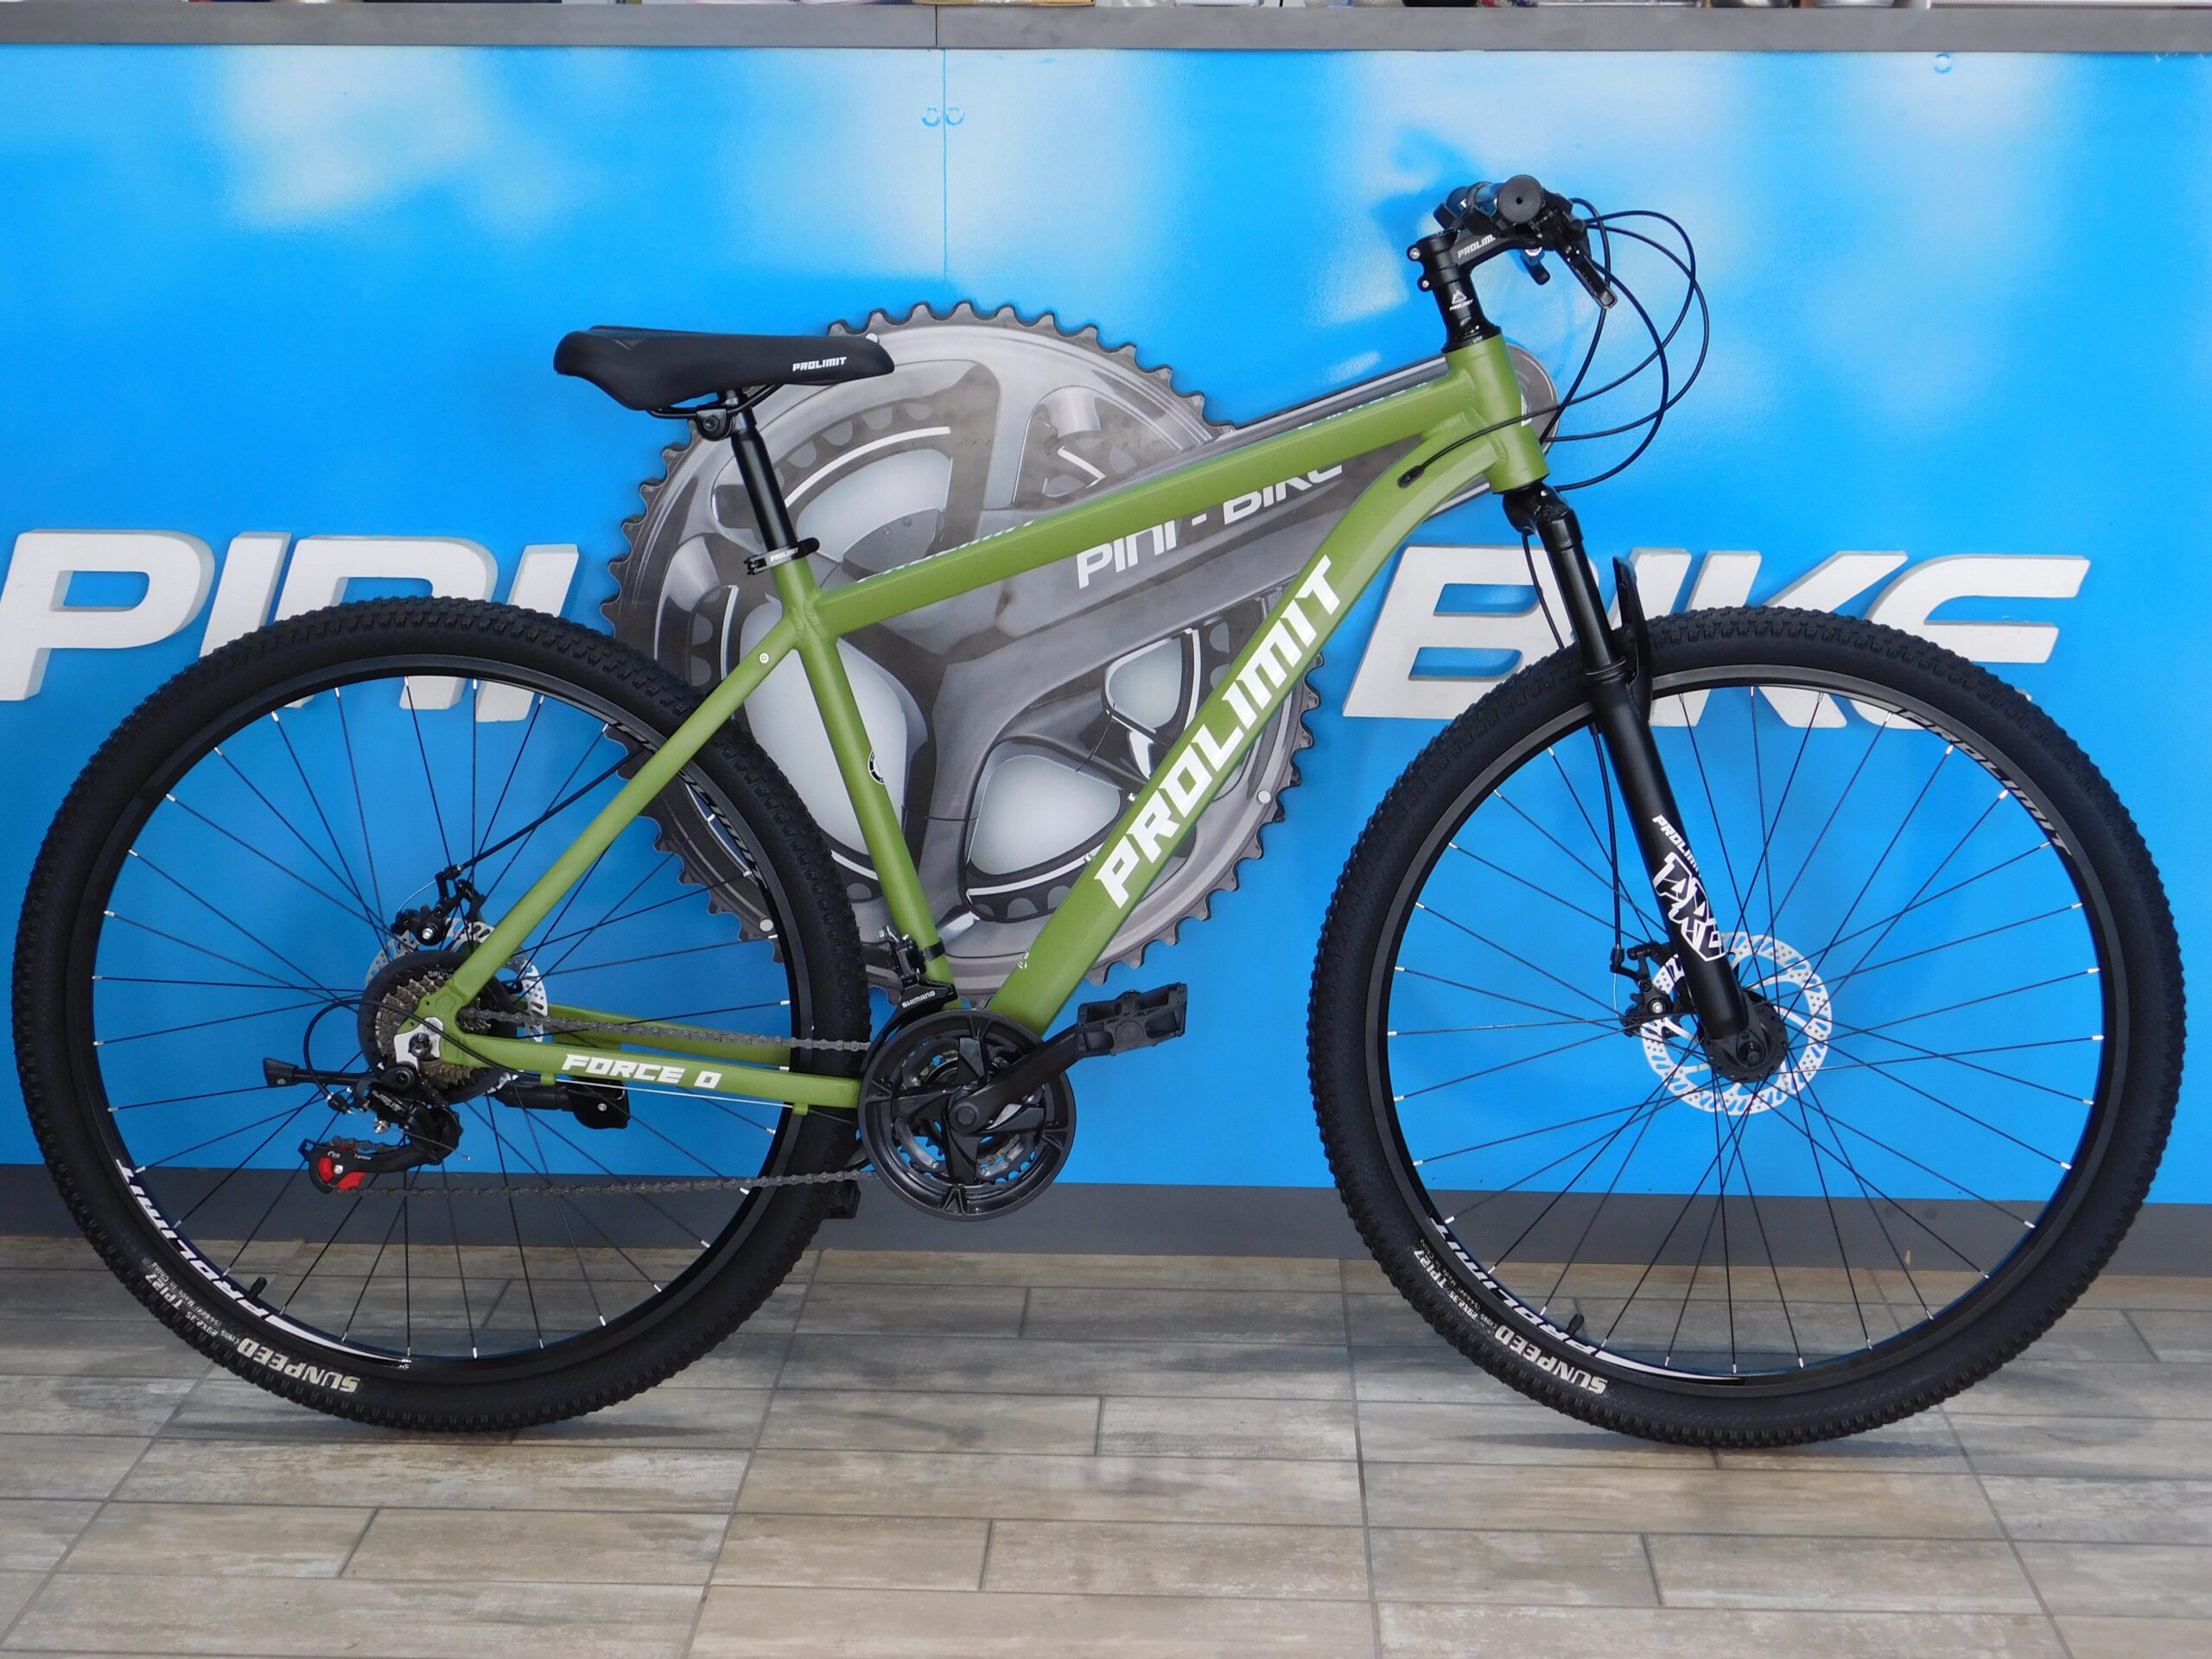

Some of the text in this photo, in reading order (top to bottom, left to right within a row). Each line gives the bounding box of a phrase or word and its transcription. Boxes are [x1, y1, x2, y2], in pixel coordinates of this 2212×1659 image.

[792, 356, 847, 372] PROLIMIT
[1343, 547, 2090, 728] BIKE
[1094, 554, 1341, 909] PROLIMIT
[1901, 709, 2072, 856] PROLIMIT
[901, 989, 936, 1009] SHIMANO
[562, 1054, 685, 1084] FORCE
[116, 1159, 269, 1319] PROLIMIT
[152, 1261, 170, 1283] China
[178, 1289, 195, 1307] Made
[1430, 1217, 1605, 1356] PROLIMIT
[1442, 1268, 1458, 1287] Made
[237, 1338, 361, 1394] SUNPEED
[1494, 1325, 1609, 1395] SUNPEED
